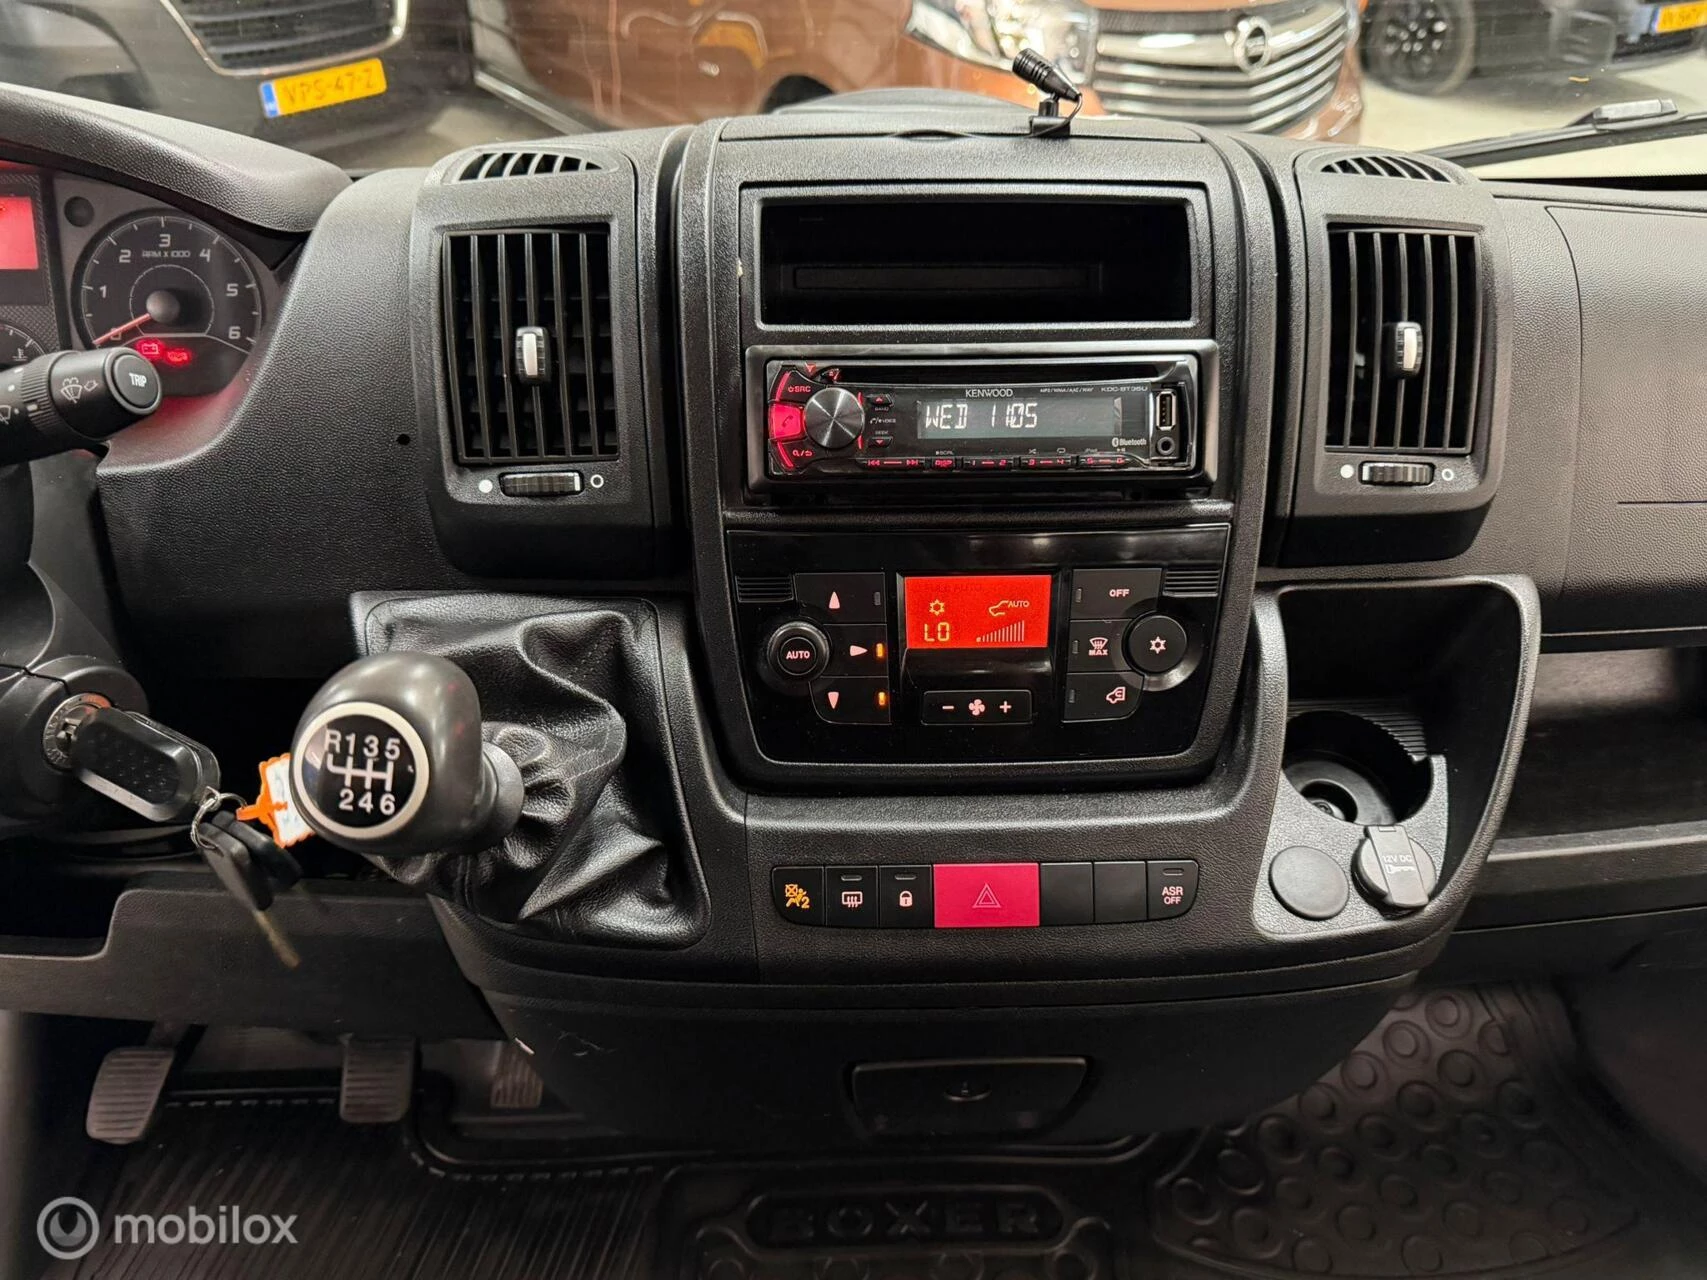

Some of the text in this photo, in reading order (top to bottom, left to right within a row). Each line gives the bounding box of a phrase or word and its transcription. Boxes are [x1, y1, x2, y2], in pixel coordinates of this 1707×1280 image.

[159, 233, 171, 247] 3
[119, 249, 131, 263] 2
[199, 248, 211, 262] 4
[99, 285, 107, 298] 1
[226, 283, 239, 297] 5
[228, 326, 241, 340] 6
[128, 372, 148, 388] TRIP
[794, 385, 812, 393] SRC
[965, 388, 1014, 398] KENWOOD
[925, 403, 968, 430] WED
[1119, 438, 1148, 446] Bluetooth
[1109, 588, 1130, 597] OFF
[1007, 600, 1030, 608] AUTO
[924, 621, 950, 642] LO
[785, 650, 811, 660] AUTO
[324, 728, 341, 754] R
[1381, 854, 1413, 863] 12V DC
[1161, 886, 1184, 896] ASR
[1163, 896, 1182, 905] OFF
[768, 1200, 1040, 1241] BOXER
